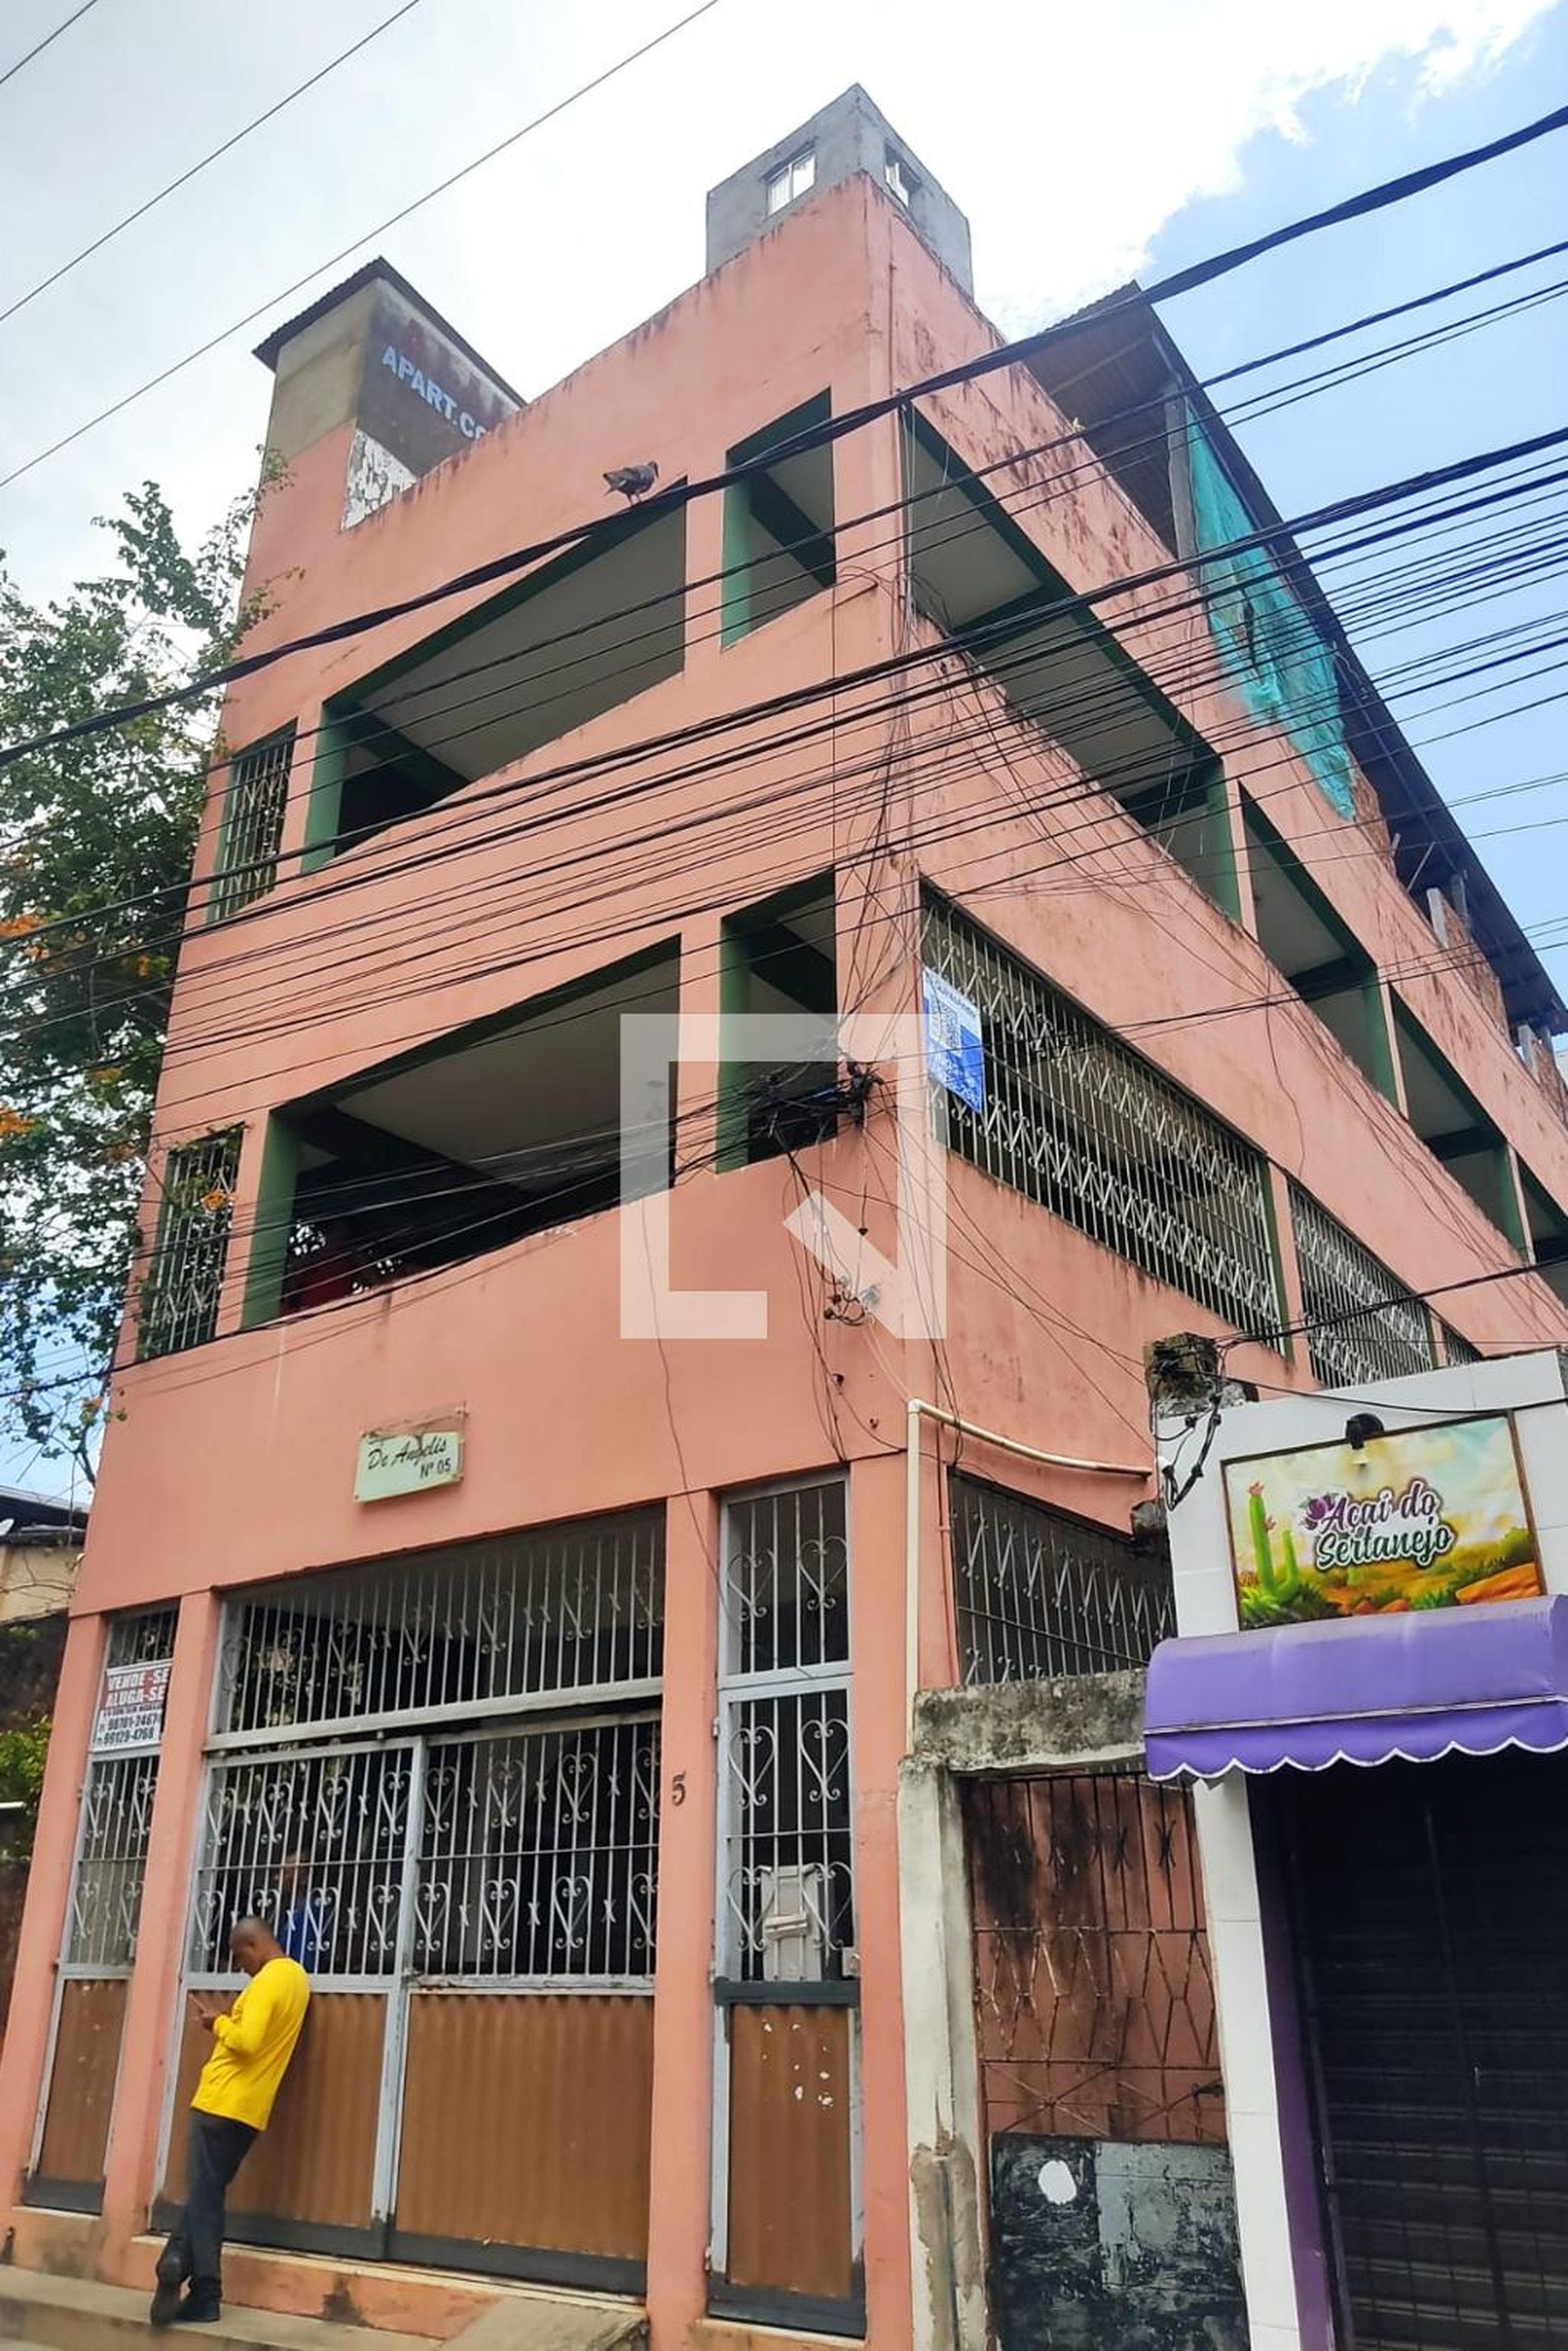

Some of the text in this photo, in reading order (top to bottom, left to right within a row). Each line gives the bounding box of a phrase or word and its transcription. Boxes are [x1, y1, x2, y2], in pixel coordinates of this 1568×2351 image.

[368, 1448, 388, 1470] De
[437, 1457, 451, 1474] 05
[1401, 1483, 1437, 1519] do
[1318, 1516, 1452, 1567] Sertanejo
[105, 1684, 166, 1707] ALUGA-SE
[672, 1769, 686, 1807] 5
